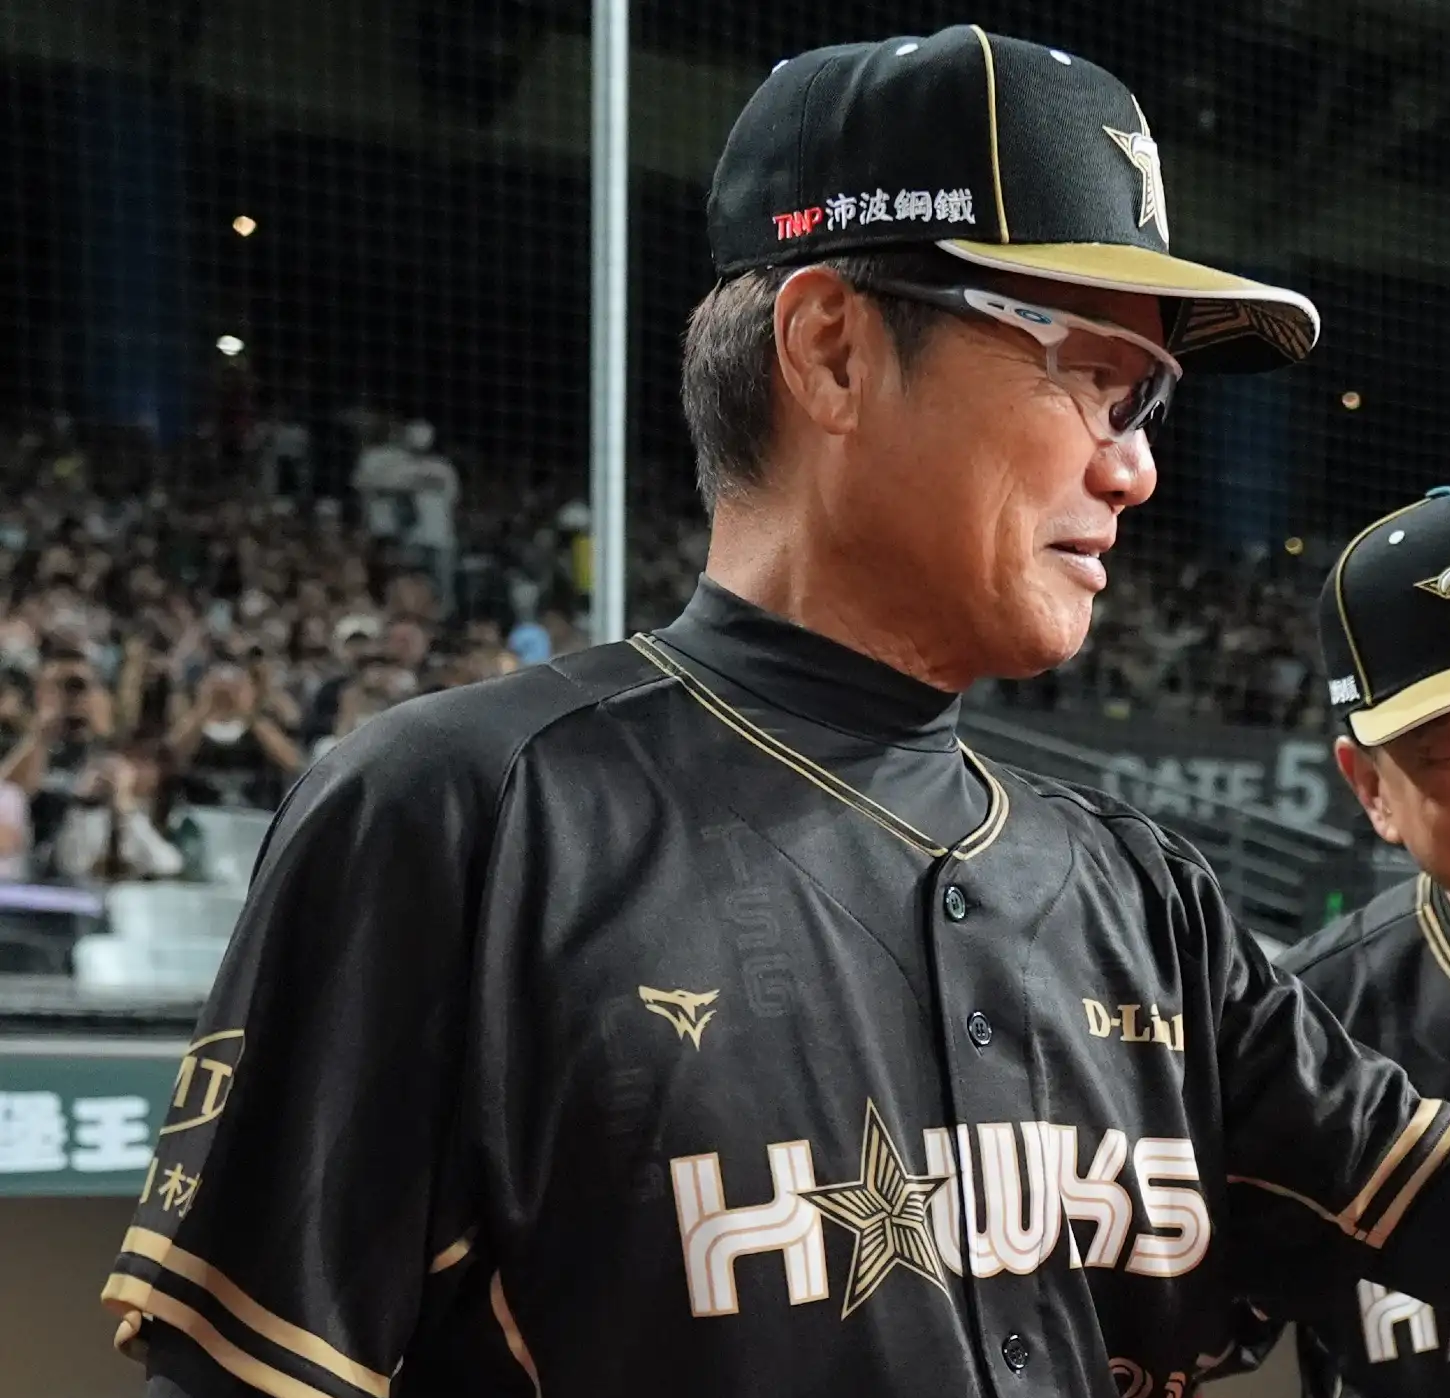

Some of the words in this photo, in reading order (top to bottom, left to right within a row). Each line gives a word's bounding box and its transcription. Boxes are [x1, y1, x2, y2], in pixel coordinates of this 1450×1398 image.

[825, 188, 976, 232] 沛波鋼鐵
[1275, 741, 1329, 824] 5
